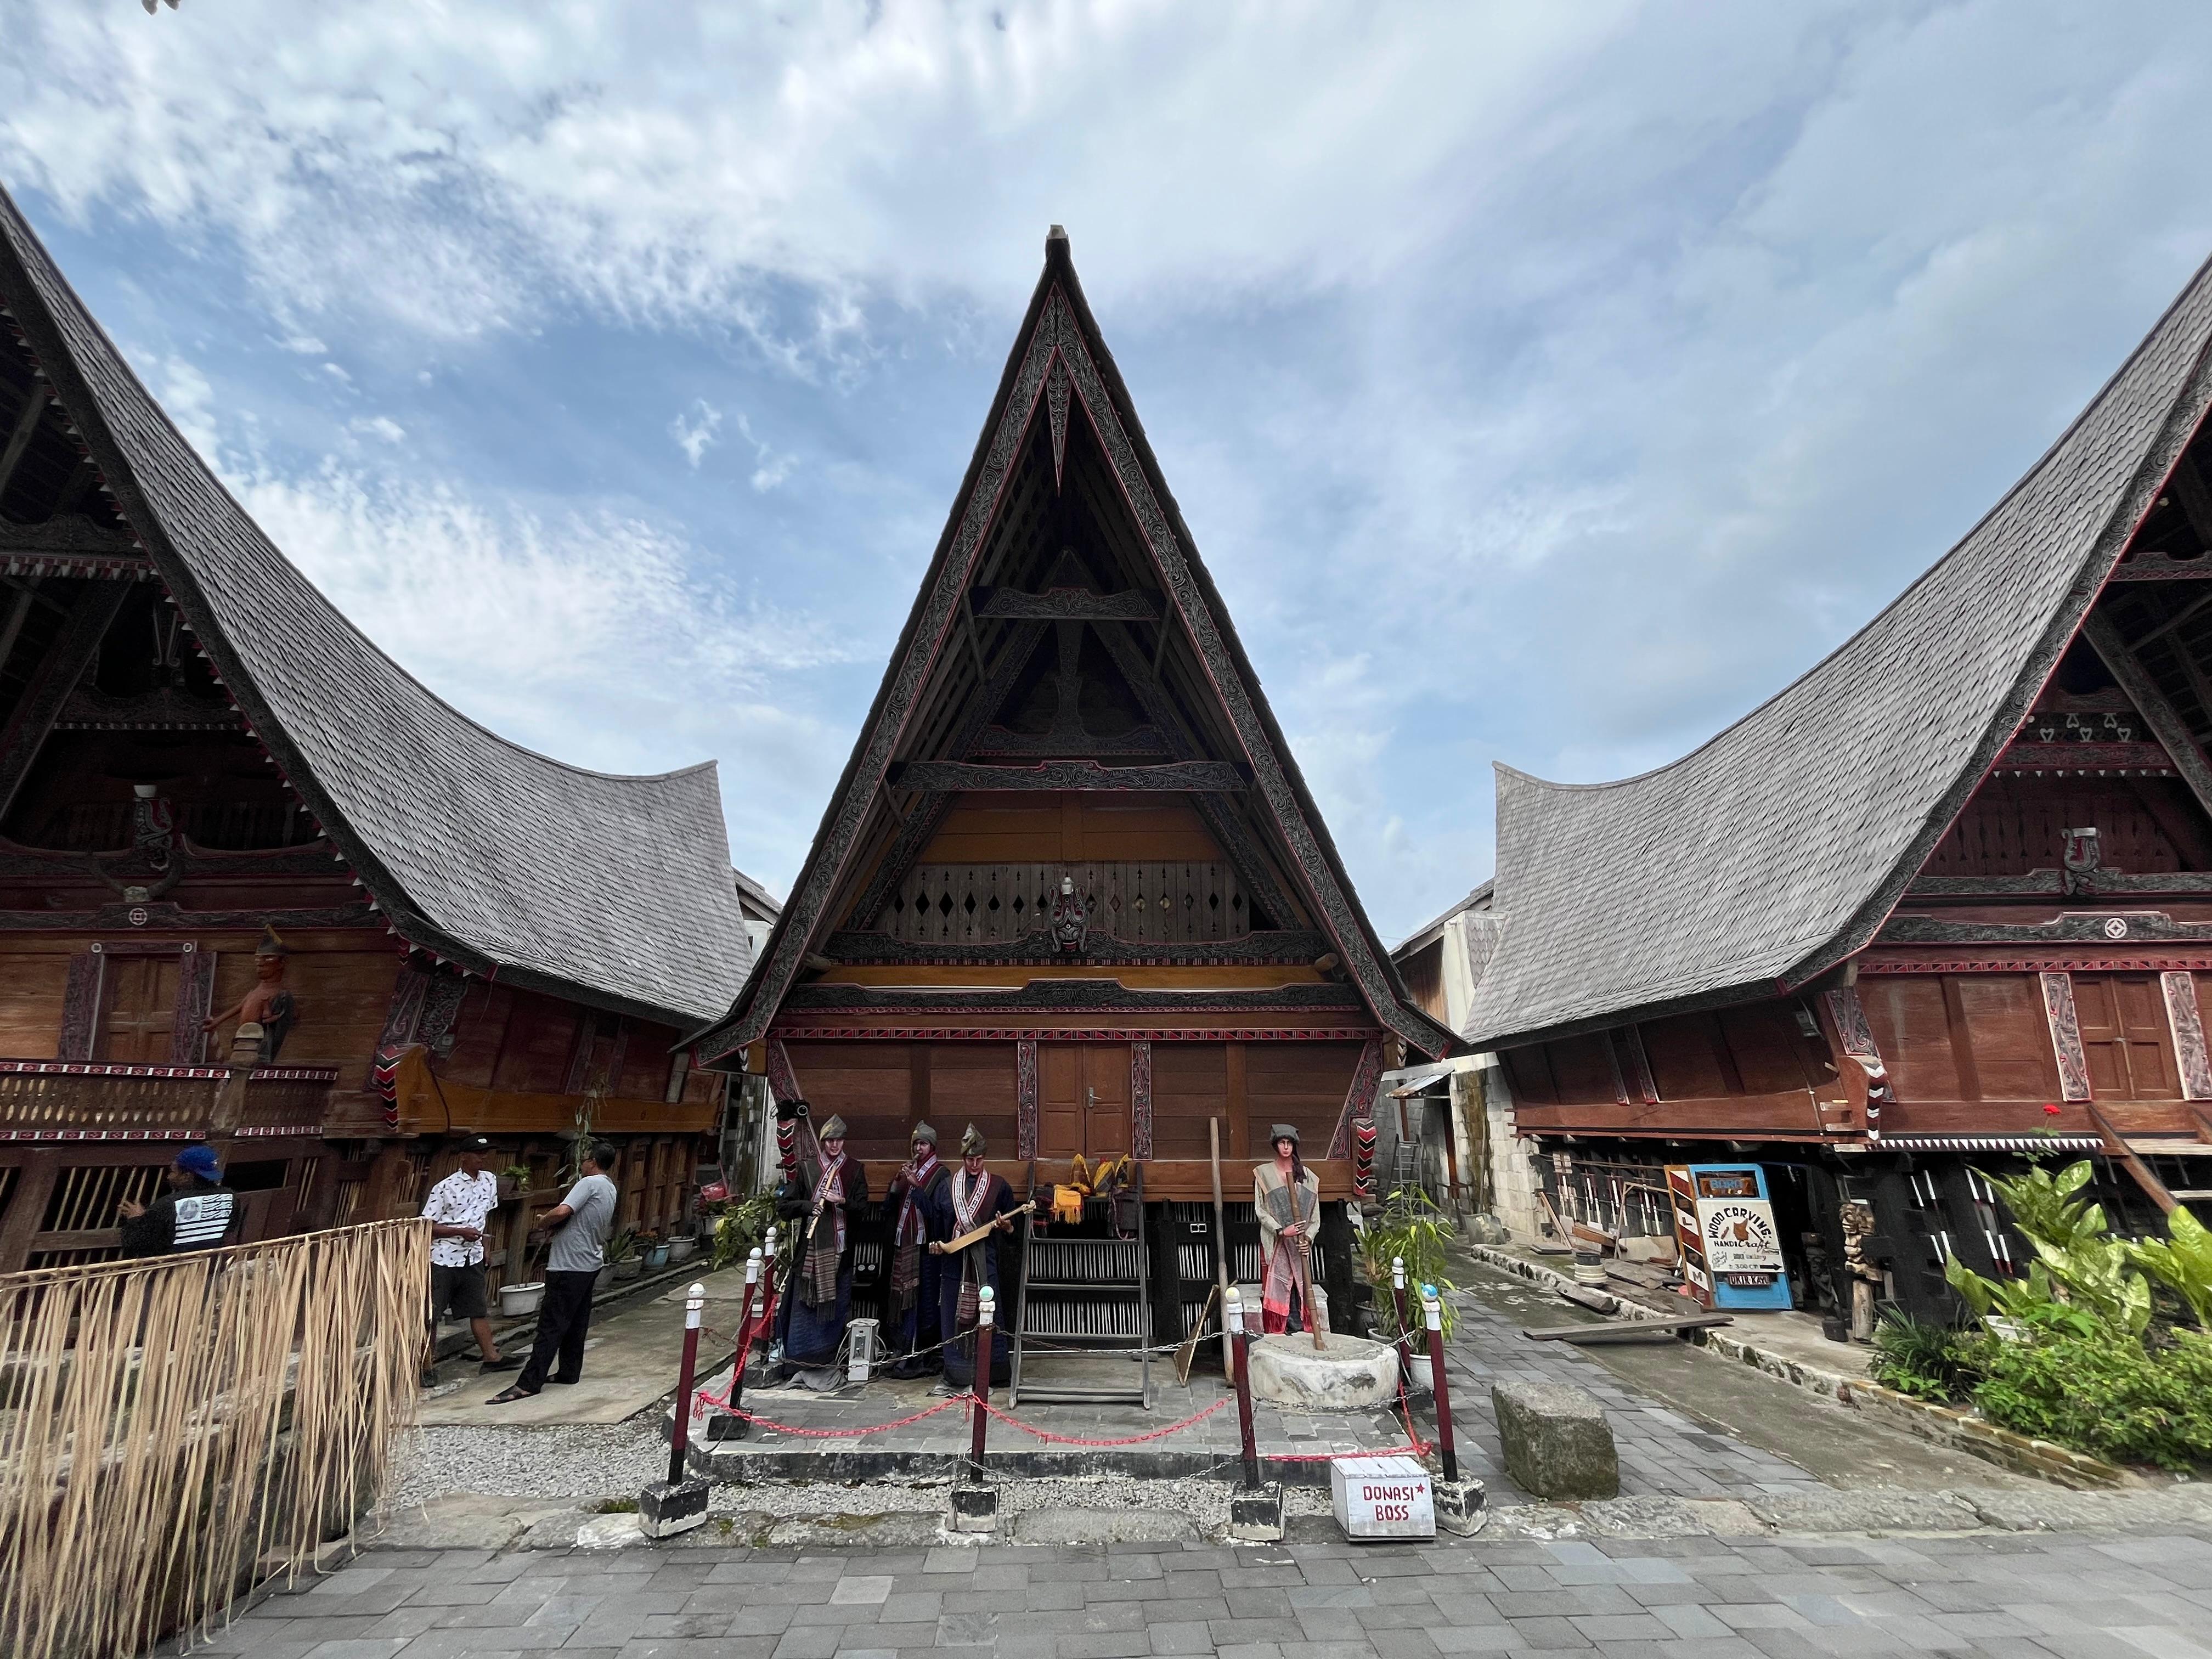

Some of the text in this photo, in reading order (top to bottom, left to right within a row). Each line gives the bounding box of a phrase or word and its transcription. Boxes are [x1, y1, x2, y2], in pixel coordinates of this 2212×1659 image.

[1708, 1212, 1725, 1239] WOOD
[1731, 1275, 1751, 1284] UKIR
[1363, 1486, 1414, 1501] DONASI
[1375, 1505, 1409, 1521] BOSS
